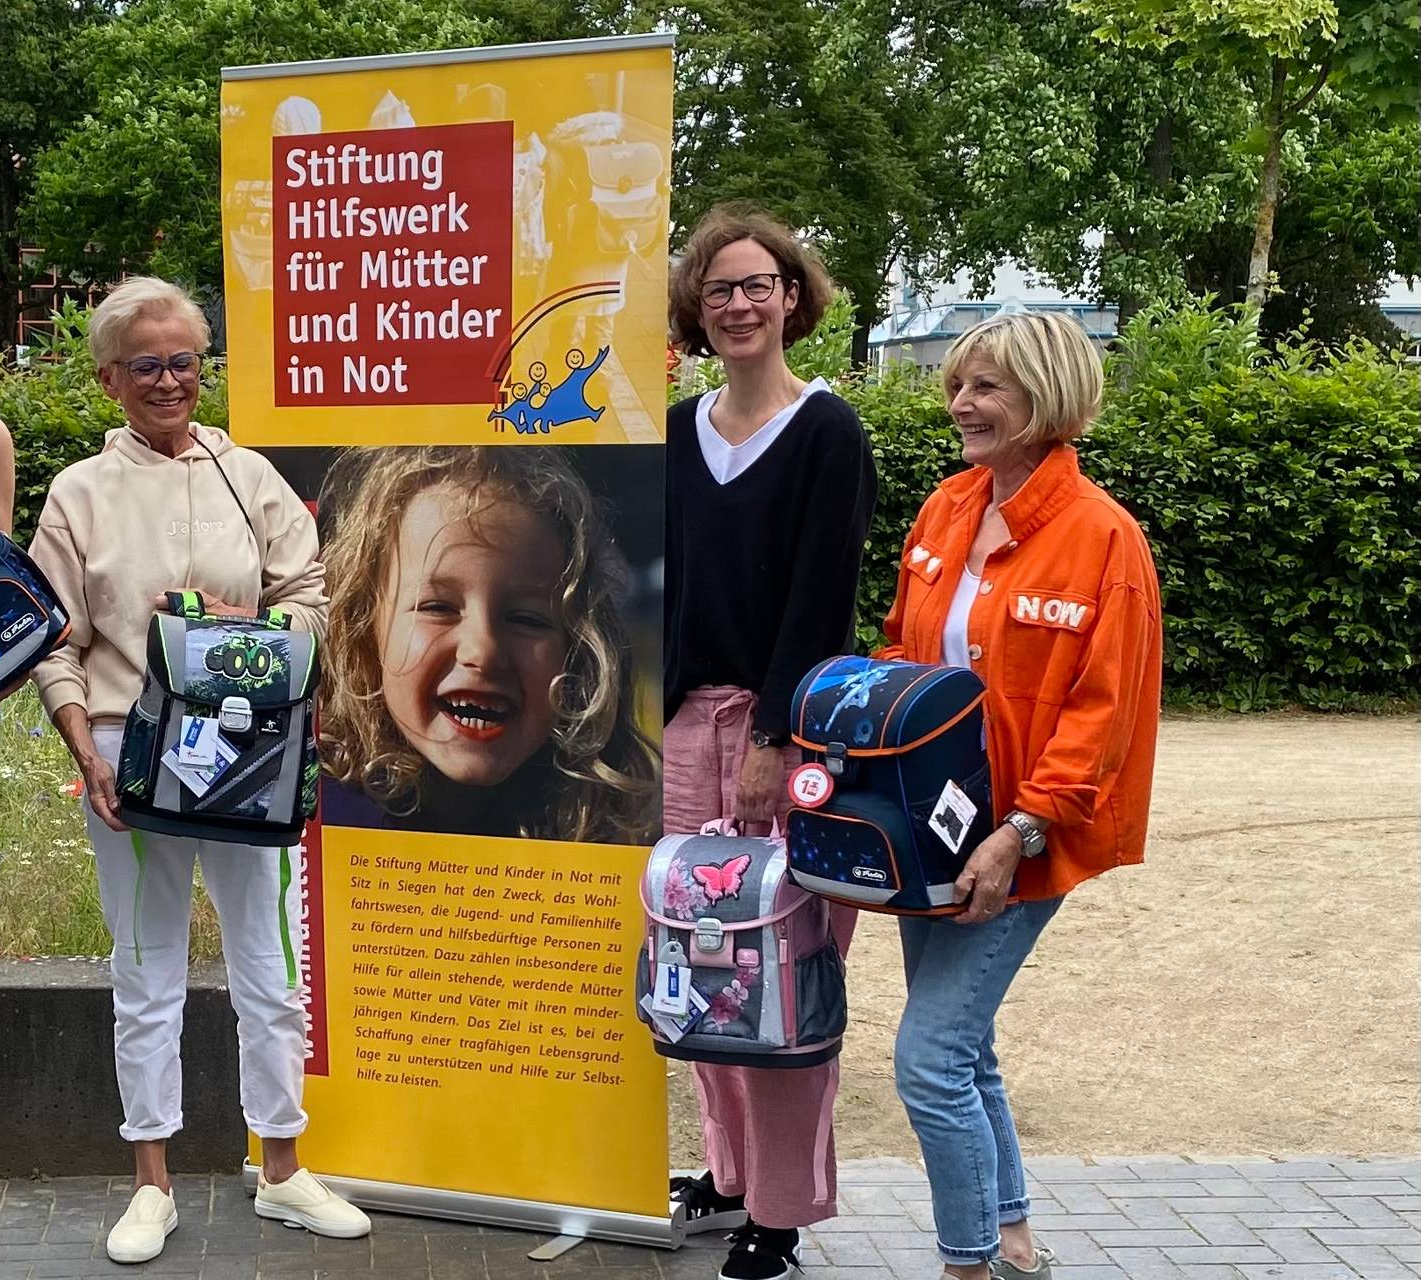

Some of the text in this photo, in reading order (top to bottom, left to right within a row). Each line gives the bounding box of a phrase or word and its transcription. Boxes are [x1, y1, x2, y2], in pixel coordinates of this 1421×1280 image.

[286, 143, 444, 191] Stiftung
[287, 191, 470, 240] Hilfswerk
[286, 247, 489, 292] für Mütter
[288, 299, 502, 344] und Kinder
[286, 354, 410, 395] in Not
[1016, 595, 1087, 628] NOW
[350, 854, 622, 886] Die Stiftung Mütter und Kinder in Not mit
[350, 876, 621, 907] Sitz in Siegen hat den Zweck, das Wohl-
[351, 897, 622, 930] fahrtswesen, die Jugend- und Familienhilfe
[351, 920, 622, 952] zu fördern und hilfsbedürftige Personen zu
[352, 943, 623, 975] unterstützen. Dazu zählen insbesondere die
[353, 962, 623, 997] Hilfe für allein stehende, werdende Mütter
[353, 985, 623, 1019] sowie Mütter und Väter mit ihren minder-
[353, 1005, 624, 1042] jährigen Kindern. Das Ziel ist es, bei der
[355, 1026, 624, 1064] Schaffung einer tragfähigen Lebensgrund-
[356, 1046, 625, 1085] lage zu unterstützen und Hilfe zur Selbst-
[357, 1067, 442, 1088] hilfe zu leisten.
